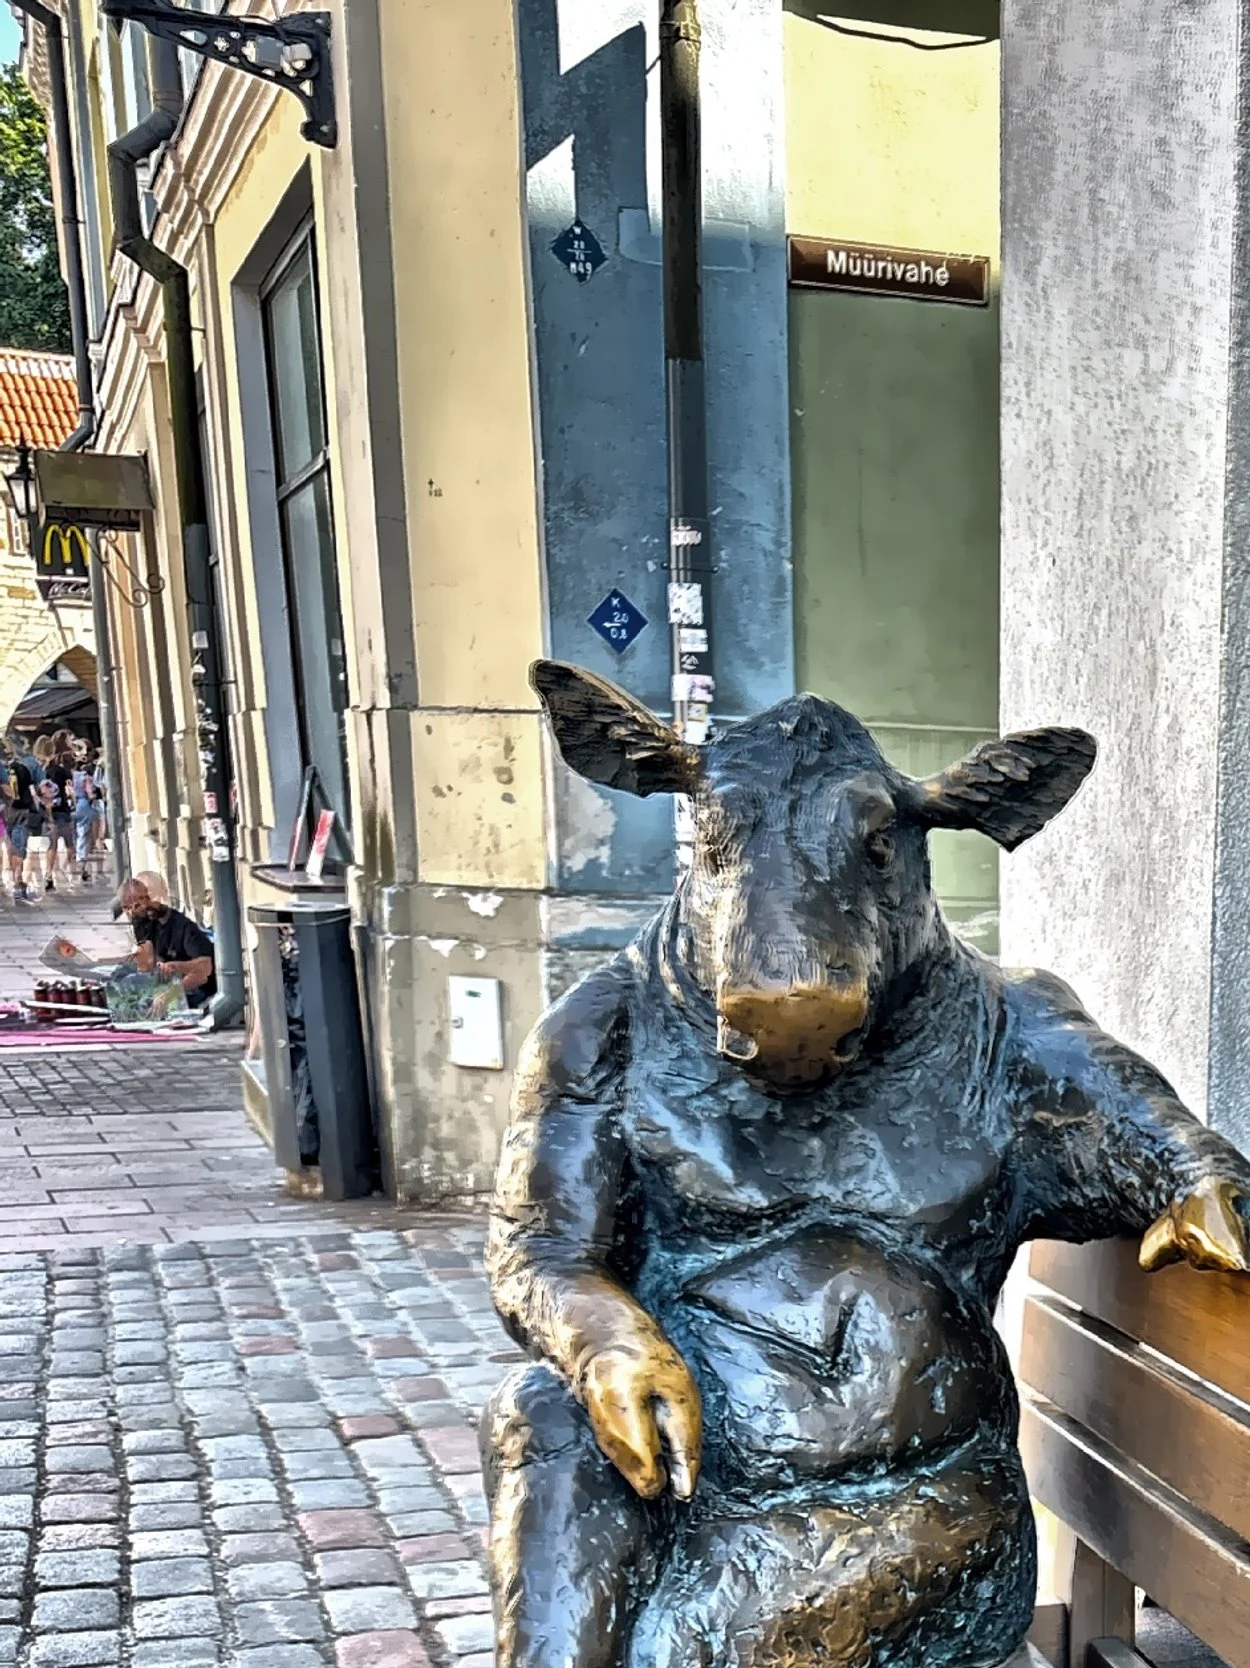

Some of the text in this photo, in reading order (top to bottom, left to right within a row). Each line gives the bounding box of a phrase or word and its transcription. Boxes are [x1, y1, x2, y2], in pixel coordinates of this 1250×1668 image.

[827, 249, 950, 287] Müürivahe
[48, 582, 93, 599] McCaf
[611, 597, 620, 608] K
